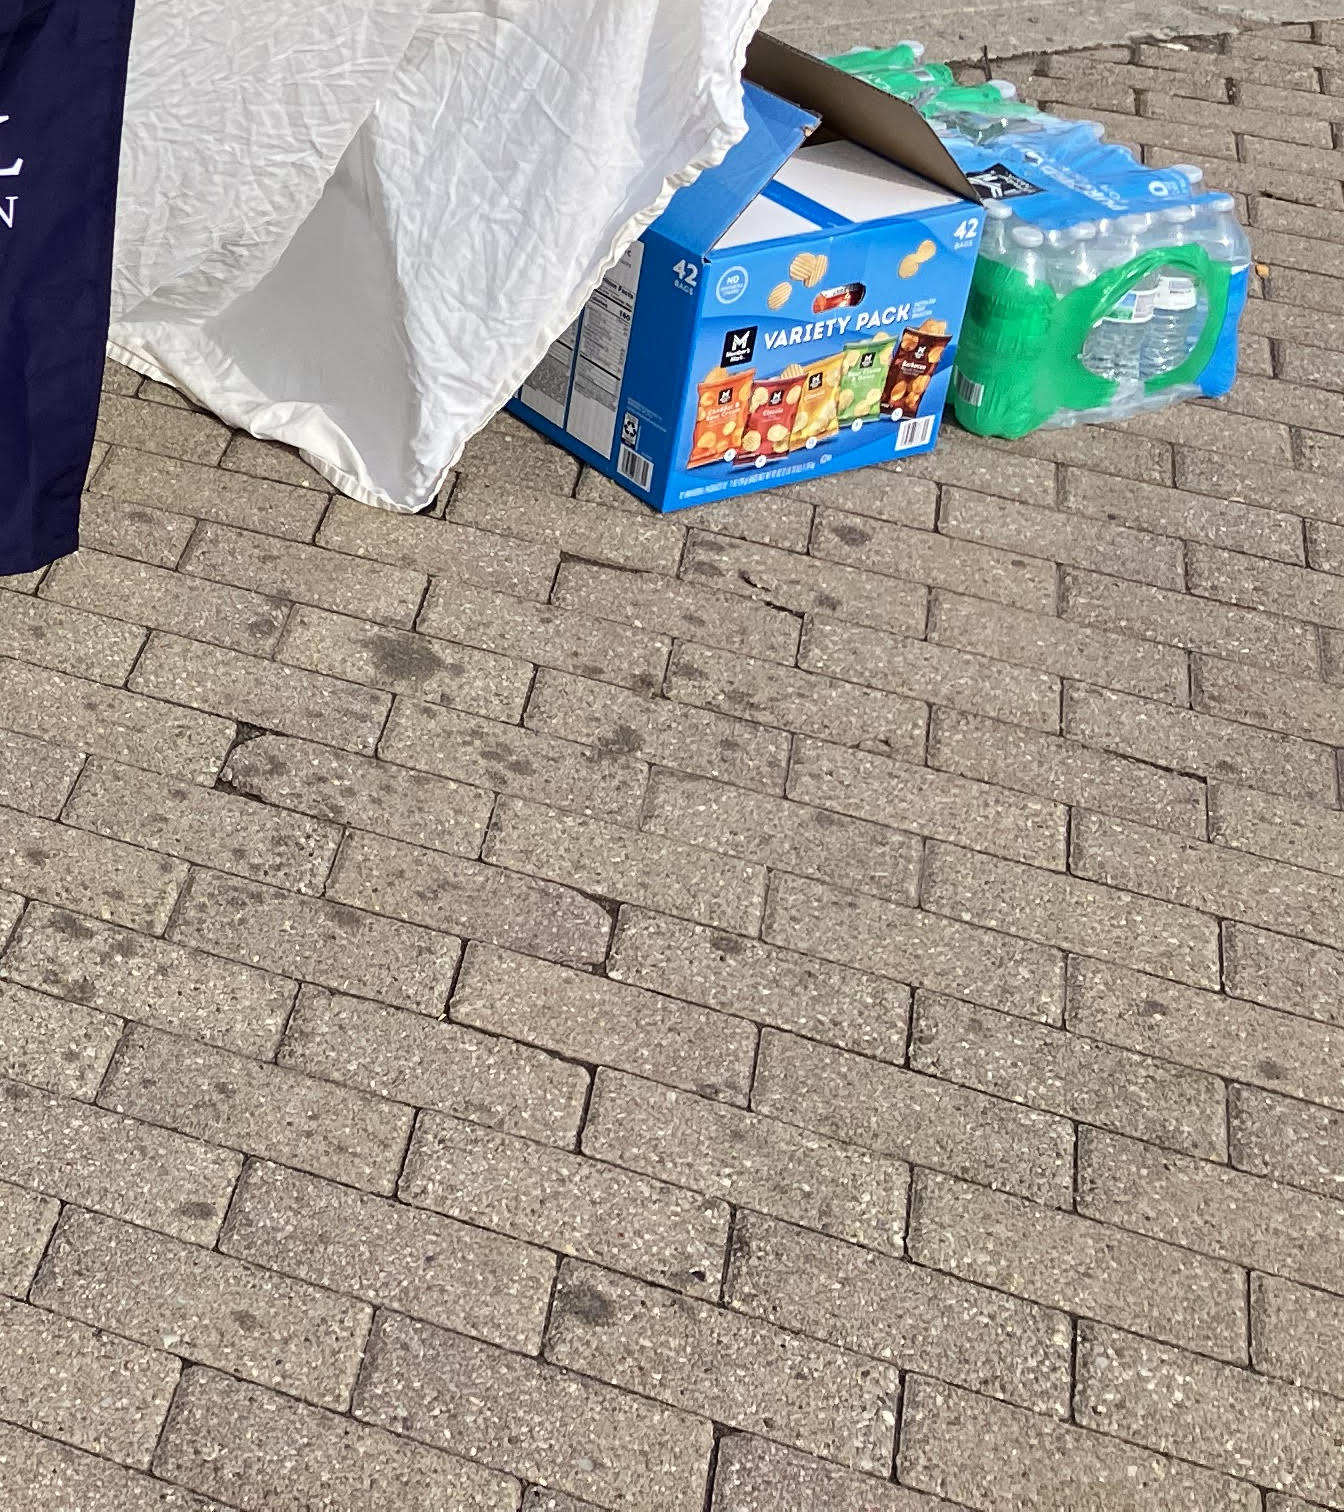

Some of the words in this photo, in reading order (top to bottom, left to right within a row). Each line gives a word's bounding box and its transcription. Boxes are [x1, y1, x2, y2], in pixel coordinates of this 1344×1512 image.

[953, 217, 978, 241] 42
[672, 258, 699, 287] 42
[763, 315, 850, 352] VARIETY
[855, 303, 911, 331] PACK
